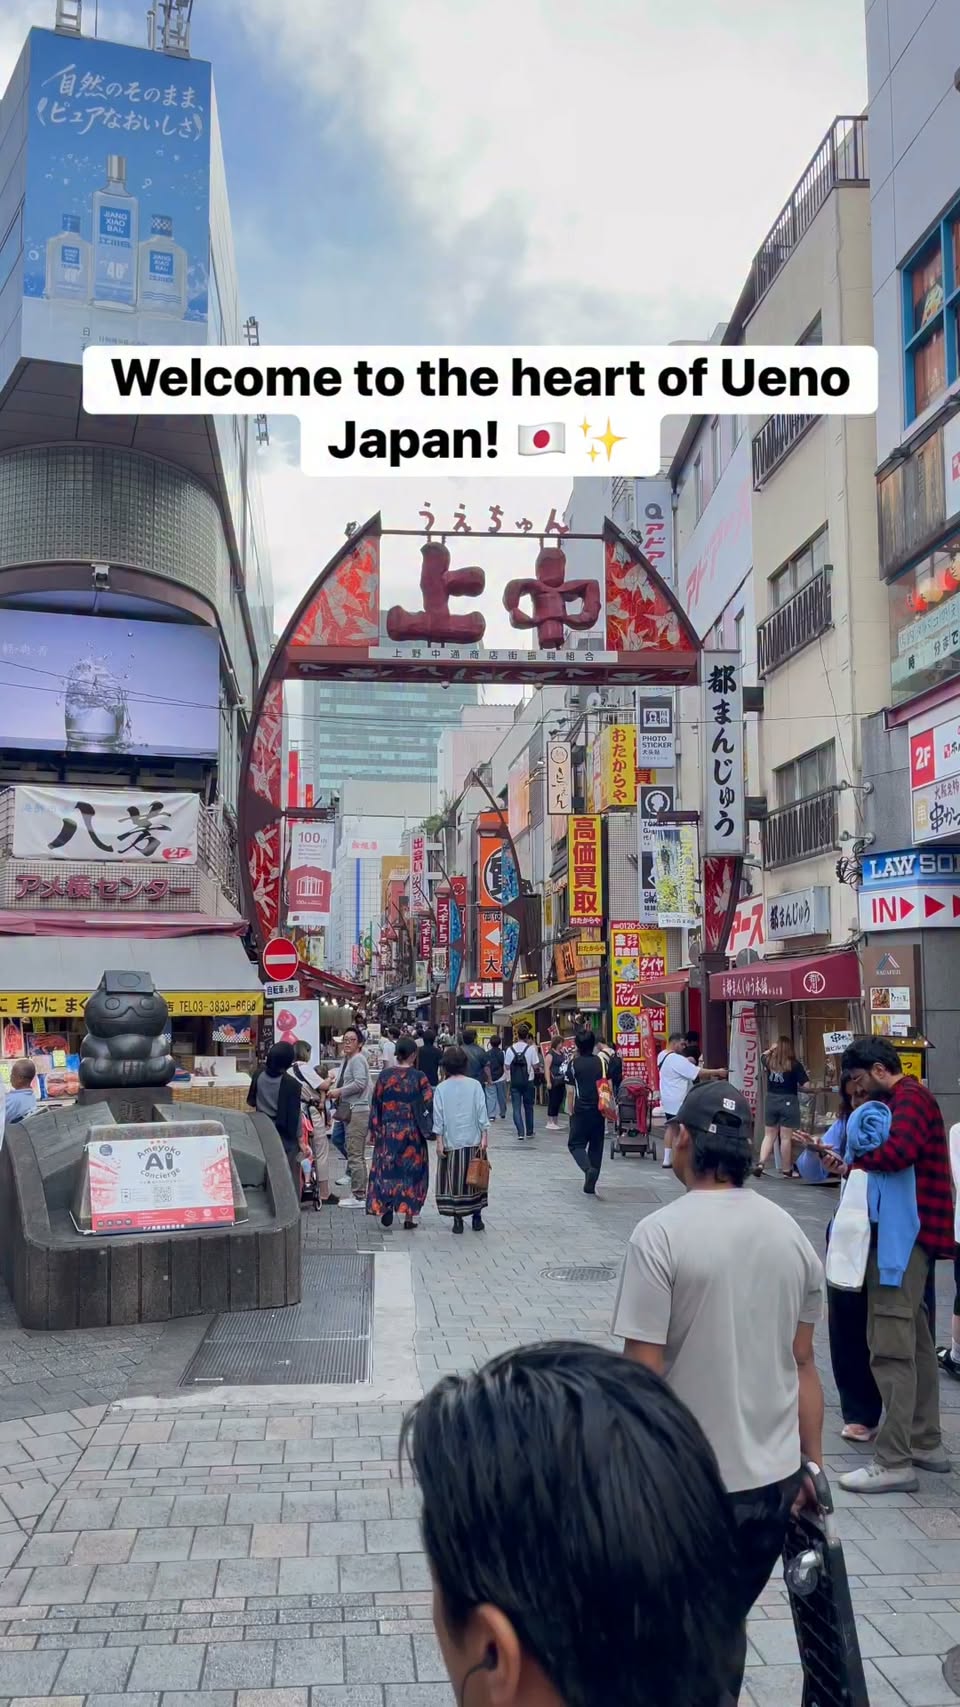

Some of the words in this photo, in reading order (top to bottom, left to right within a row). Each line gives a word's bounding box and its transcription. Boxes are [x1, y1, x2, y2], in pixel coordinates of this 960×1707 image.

[392, 650, 595, 662] 上野中通商店街振興組合
[707, 664, 738, 838] 都まんじゅう
[914, 745, 931, 771] 2F
[612, 728, 628, 803] おたからや
[169, 848, 188, 859] 2F
[573, 818, 598, 914] 高価買取
[15, 875, 193, 901] アメ横センター
[770, 899, 811, 931] 都まんじゅう
[872, 896, 897, 924] IN
[641, 958, 664, 970] ダイヤ
[16, 997, 57, 1014] 毛がに
[137, 1144, 181, 1160] Ameyoko
